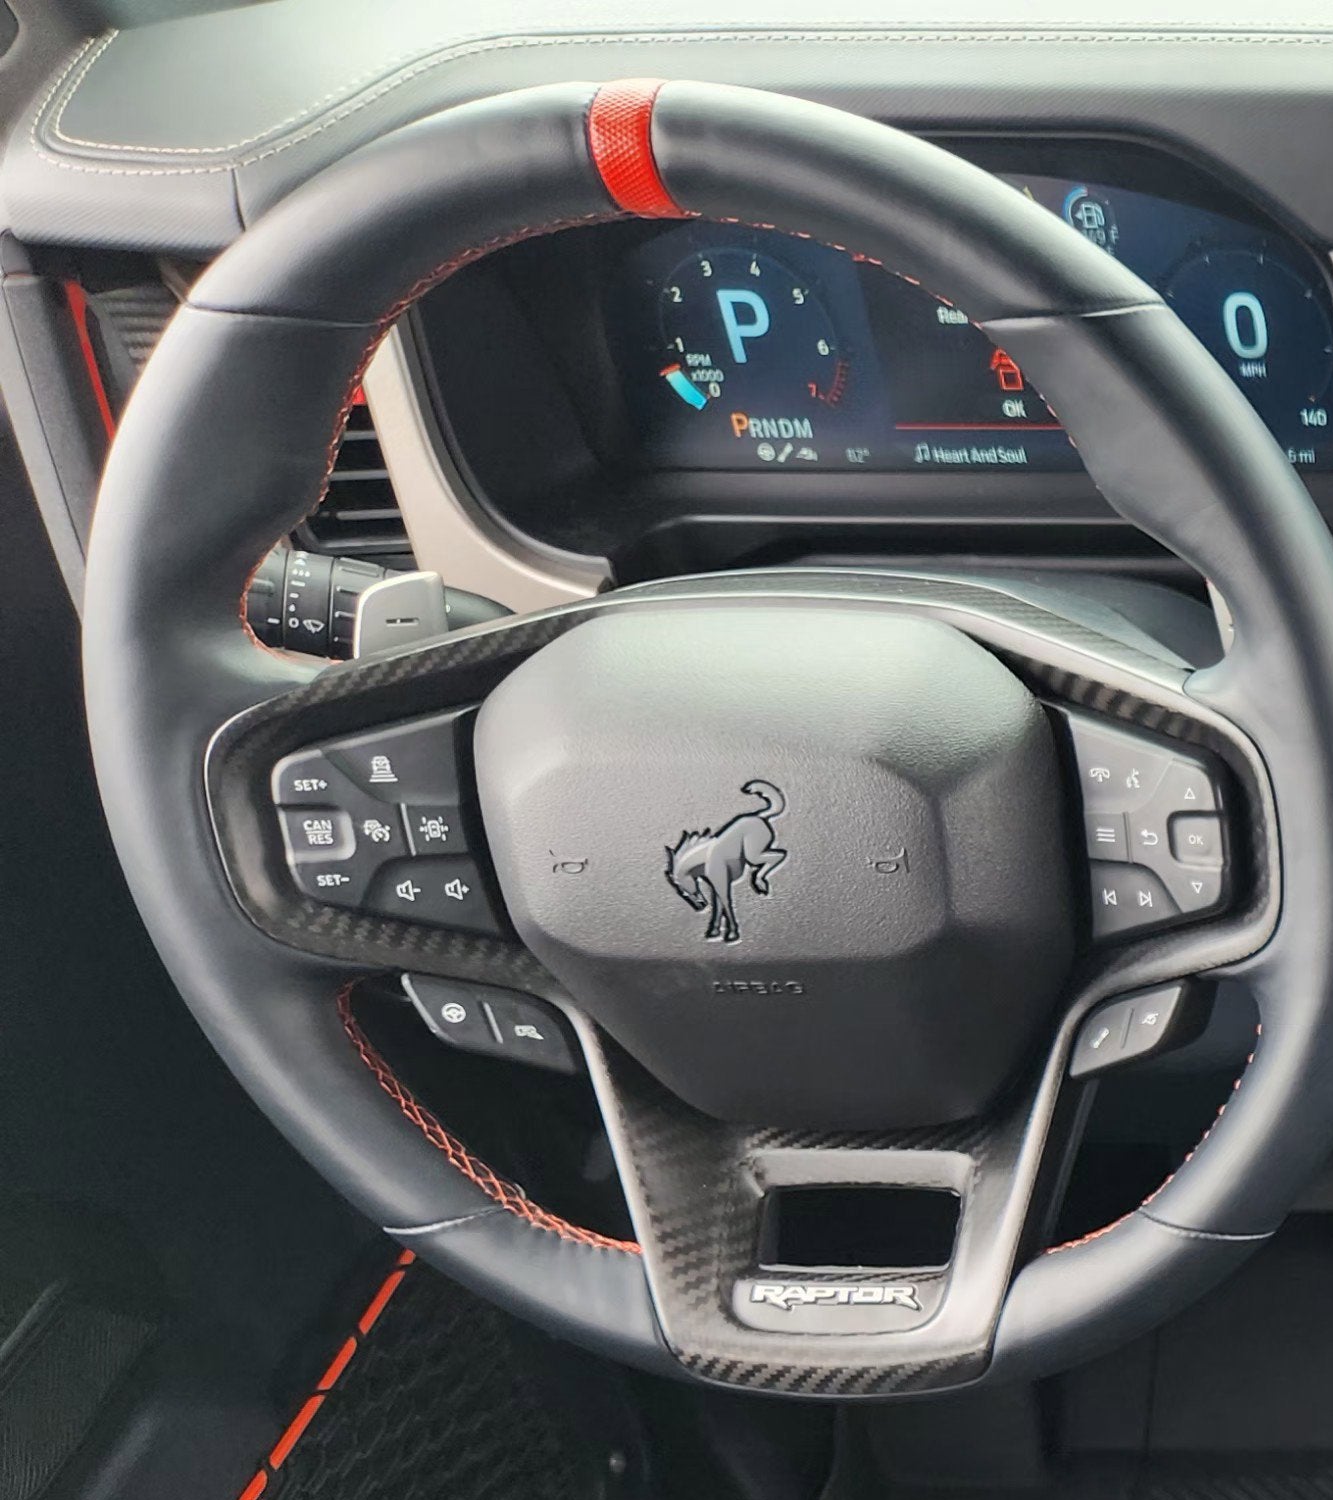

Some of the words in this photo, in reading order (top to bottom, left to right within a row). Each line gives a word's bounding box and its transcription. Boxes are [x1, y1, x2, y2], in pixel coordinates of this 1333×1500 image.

[701, 260, 712, 277] 3
[750, 261, 760, 277] 4
[671, 286, 682, 302] 2
[792, 288, 804, 304] 5
[716, 289, 770, 363] P
[1223, 292, 1268, 359] 0
[675, 337, 684, 352] 1
[817, 339, 829, 356] 6
[685, 353, 712, 366] RPM
[691, 369, 724, 382] x1000
[1240, 362, 1267, 378] MPH
[709, 382, 721, 398] 0
[808, 383, 817, 397] 7
[1002, 399, 1027, 417] OK
[730, 411, 813, 438] PRNDM
[1300, 408, 1327, 426] 140
[933, 445, 970, 464] Heart
[972, 445, 998, 464] And
[998, 445, 1027, 464] Soul
[304, 820, 332, 832] CAN
[308, 833, 333, 845] RES
[1188, 834, 1204, 846] OK
[752, 1284, 923, 1311] RAPTOR
